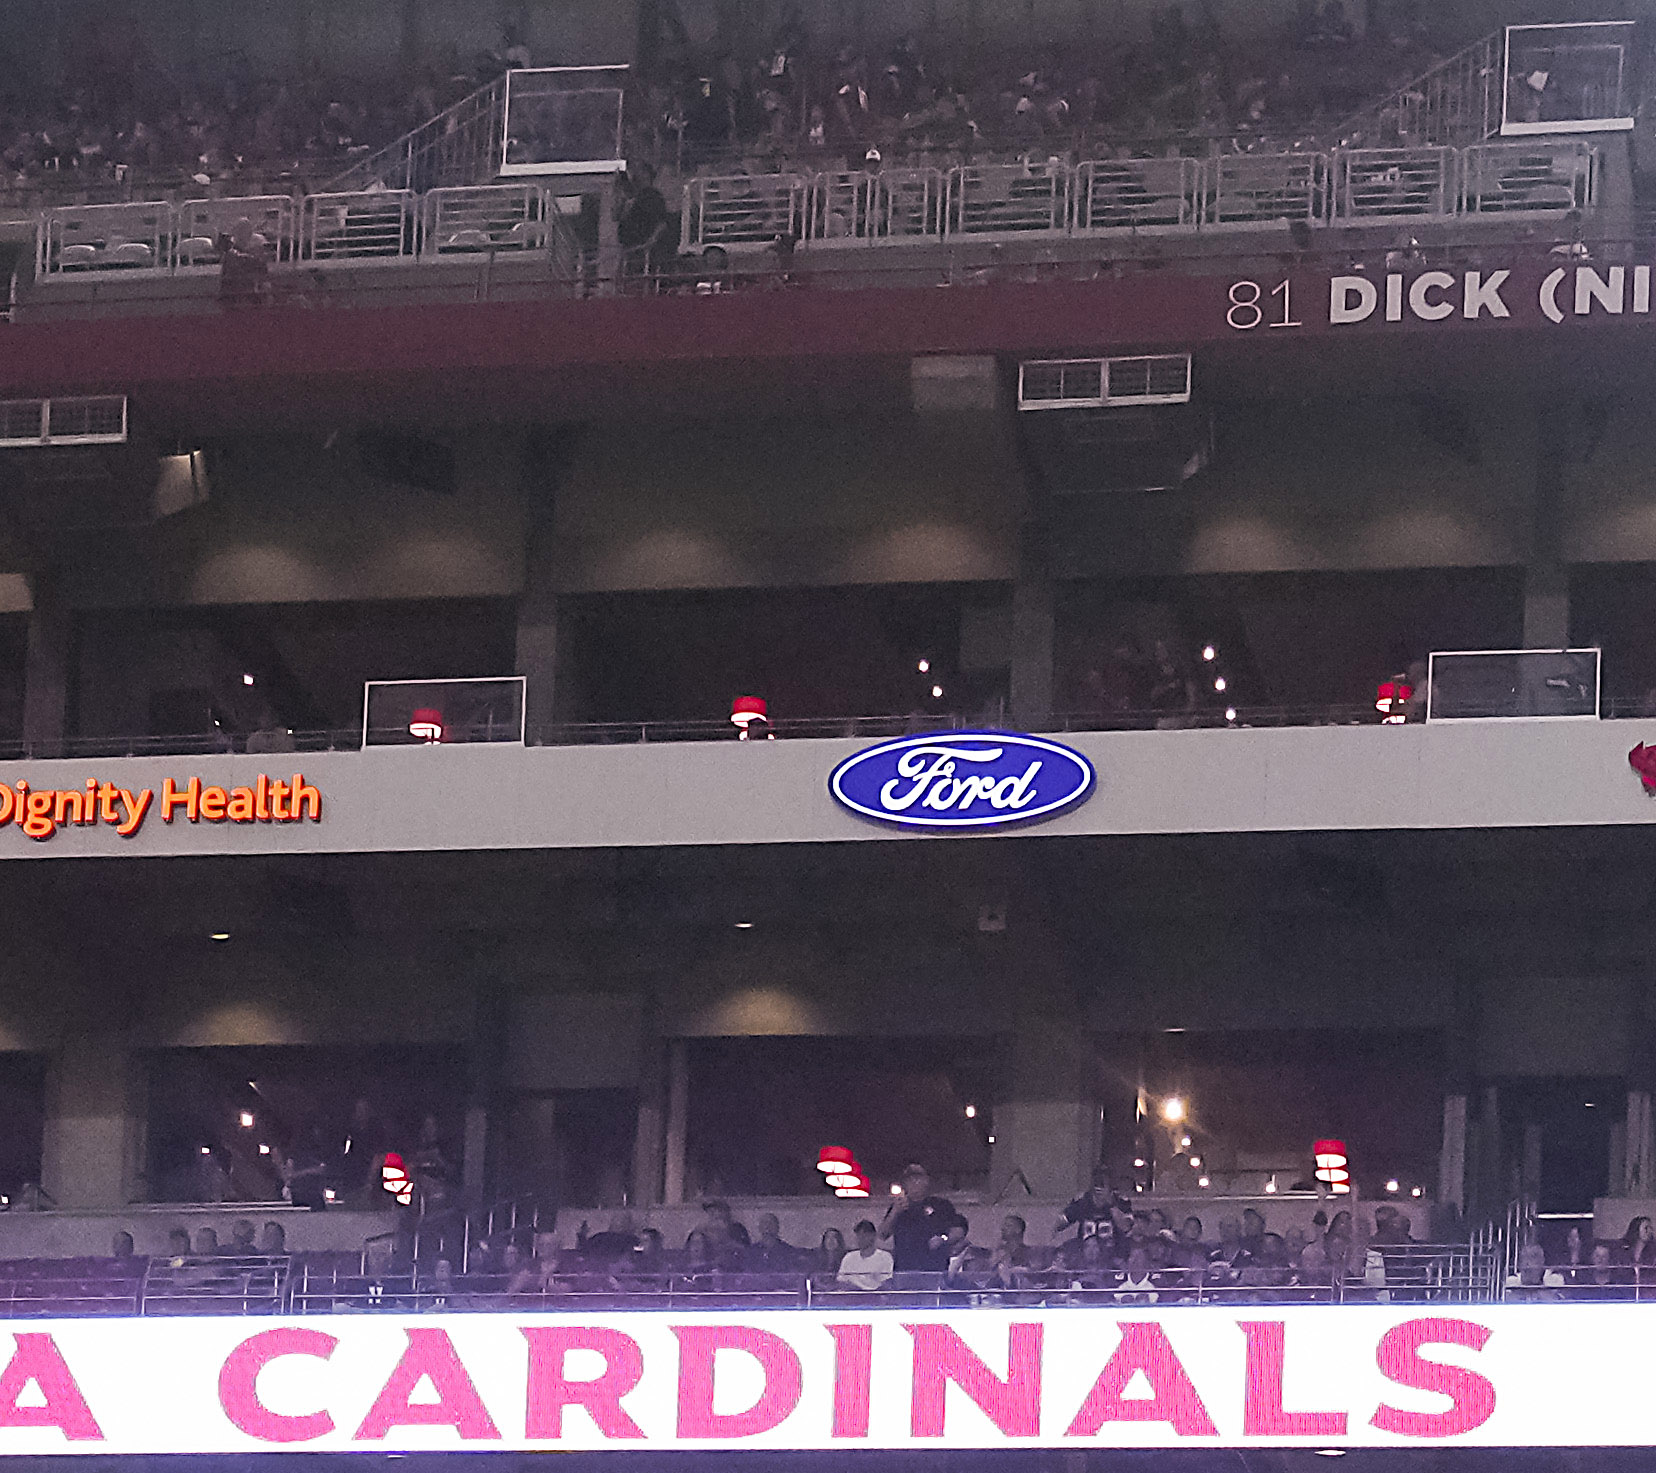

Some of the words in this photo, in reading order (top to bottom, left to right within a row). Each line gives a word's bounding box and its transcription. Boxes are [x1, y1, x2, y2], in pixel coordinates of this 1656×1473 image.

[1225, 278, 1302, 331] 81
[1328, 269, 1510, 324] DICK
[160, 773, 321, 823] Health
[879, 745, 1040, 813] Ford
[218, 1317, 1497, 1442] CARDINALS
